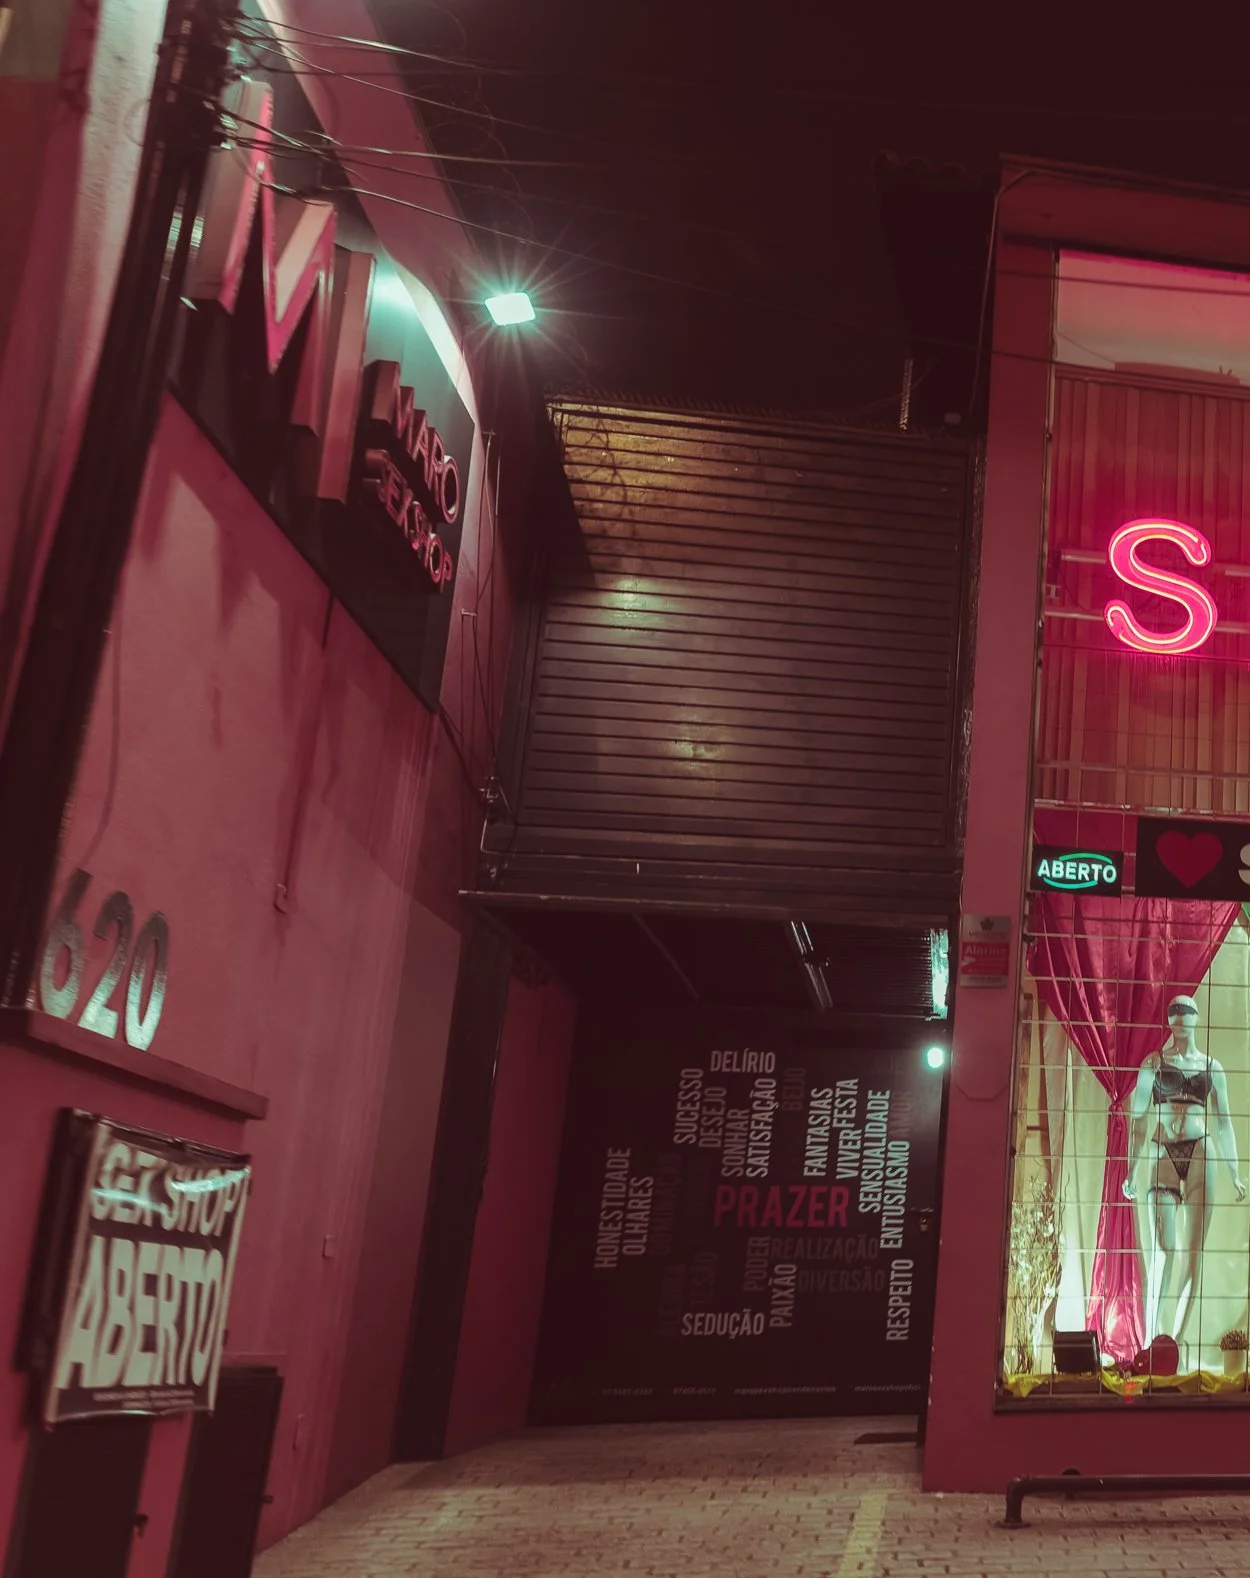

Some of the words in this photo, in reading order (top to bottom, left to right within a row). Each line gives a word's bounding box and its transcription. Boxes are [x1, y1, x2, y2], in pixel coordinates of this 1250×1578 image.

[1036, 857, 1118, 884] ABERTO
[40, 868, 169, 1050] 620
[710, 1048, 776, 1074] DELÍRIO
[673, 1068, 704, 1145] SUCESSO
[700, 1087, 727, 1148] DESEJO
[746, 1078, 780, 1178] SATISFAÇÃO
[803, 1087, 833, 1178] FANTASIAS
[833, 1078, 860, 1128] FESTA
[721, 1108, 750, 1177] SONHAR
[836, 1127, 862, 1180] VIVER
[858, 1089, 890, 1214] SENSUALIDADE
[160, 1166, 242, 1238] SHOP
[594, 1147, 631, 1268] HONESTIDADE
[622, 1176, 655, 1257] OLHARES
[713, 1185, 850, 1228] PRAZER
[880, 1140, 911, 1249] ENTUSIASMO
[743, 1236, 771, 1293] PODER
[771, 1235, 879, 1260] REALIZAÇÃO
[797, 1267, 885, 1293] DIVERSÃO
[55, 1235, 224, 1390] ABERTO
[681, 1305, 765, 1339] SEDUÇÃO
[769, 1264, 797, 1328] PAIXÃO
[886, 1258, 914, 1341] RESPEITO
